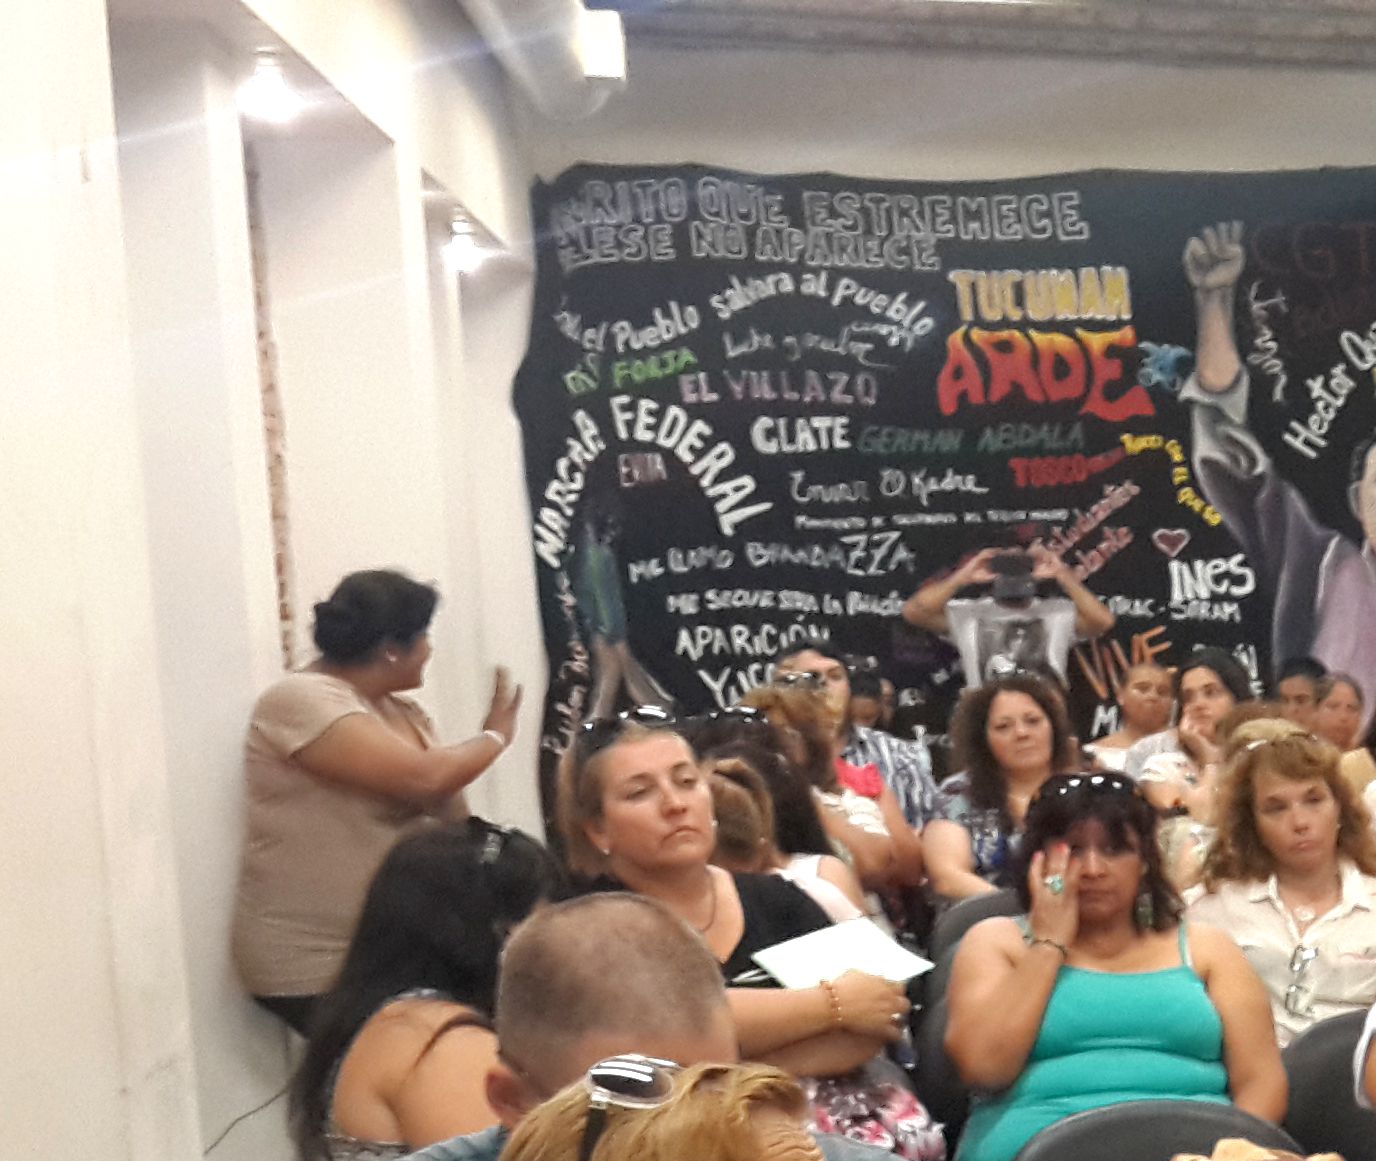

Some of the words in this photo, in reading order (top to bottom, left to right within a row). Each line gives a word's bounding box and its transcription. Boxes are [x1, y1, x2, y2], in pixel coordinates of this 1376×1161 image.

[802, 191, 1090, 241] ESTREMECE
[946, 265, 1133, 321] TUCUMAN
[610, 301, 699, 353] Pueblo
[723, 369, 878, 406] VILLAZO
[937, 325, 1156, 422] ARDE
[751, 415, 851, 454] CLATE
[610, 395, 774, 536] FEDERAL
